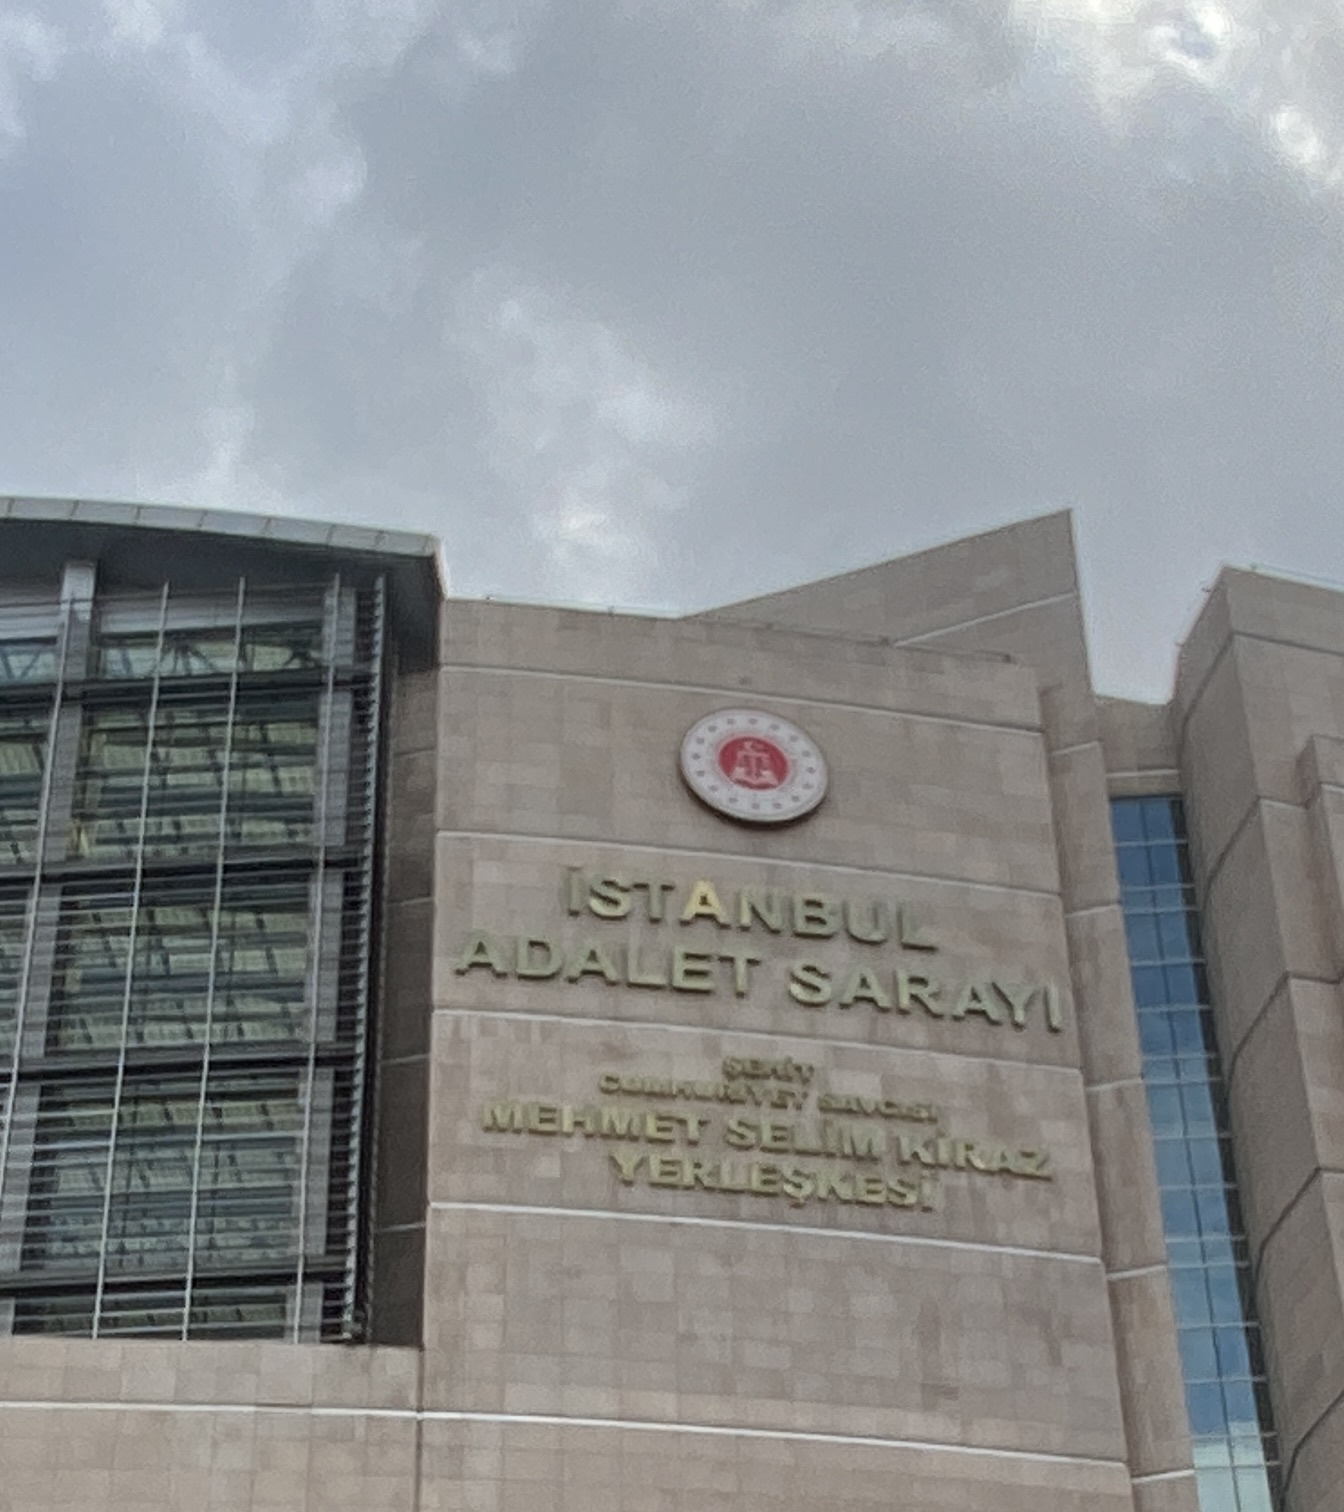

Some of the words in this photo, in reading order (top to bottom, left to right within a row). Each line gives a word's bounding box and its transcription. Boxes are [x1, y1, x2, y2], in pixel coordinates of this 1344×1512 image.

[564, 866, 938, 951] İSTANBUL
[455, 929, 761, 998] ADALET
[788, 958, 1063, 1033] SARAYI
[483, 1102, 710, 1146] MEHMET
[609, 1150, 934, 1212] YERLEŞKESİ
